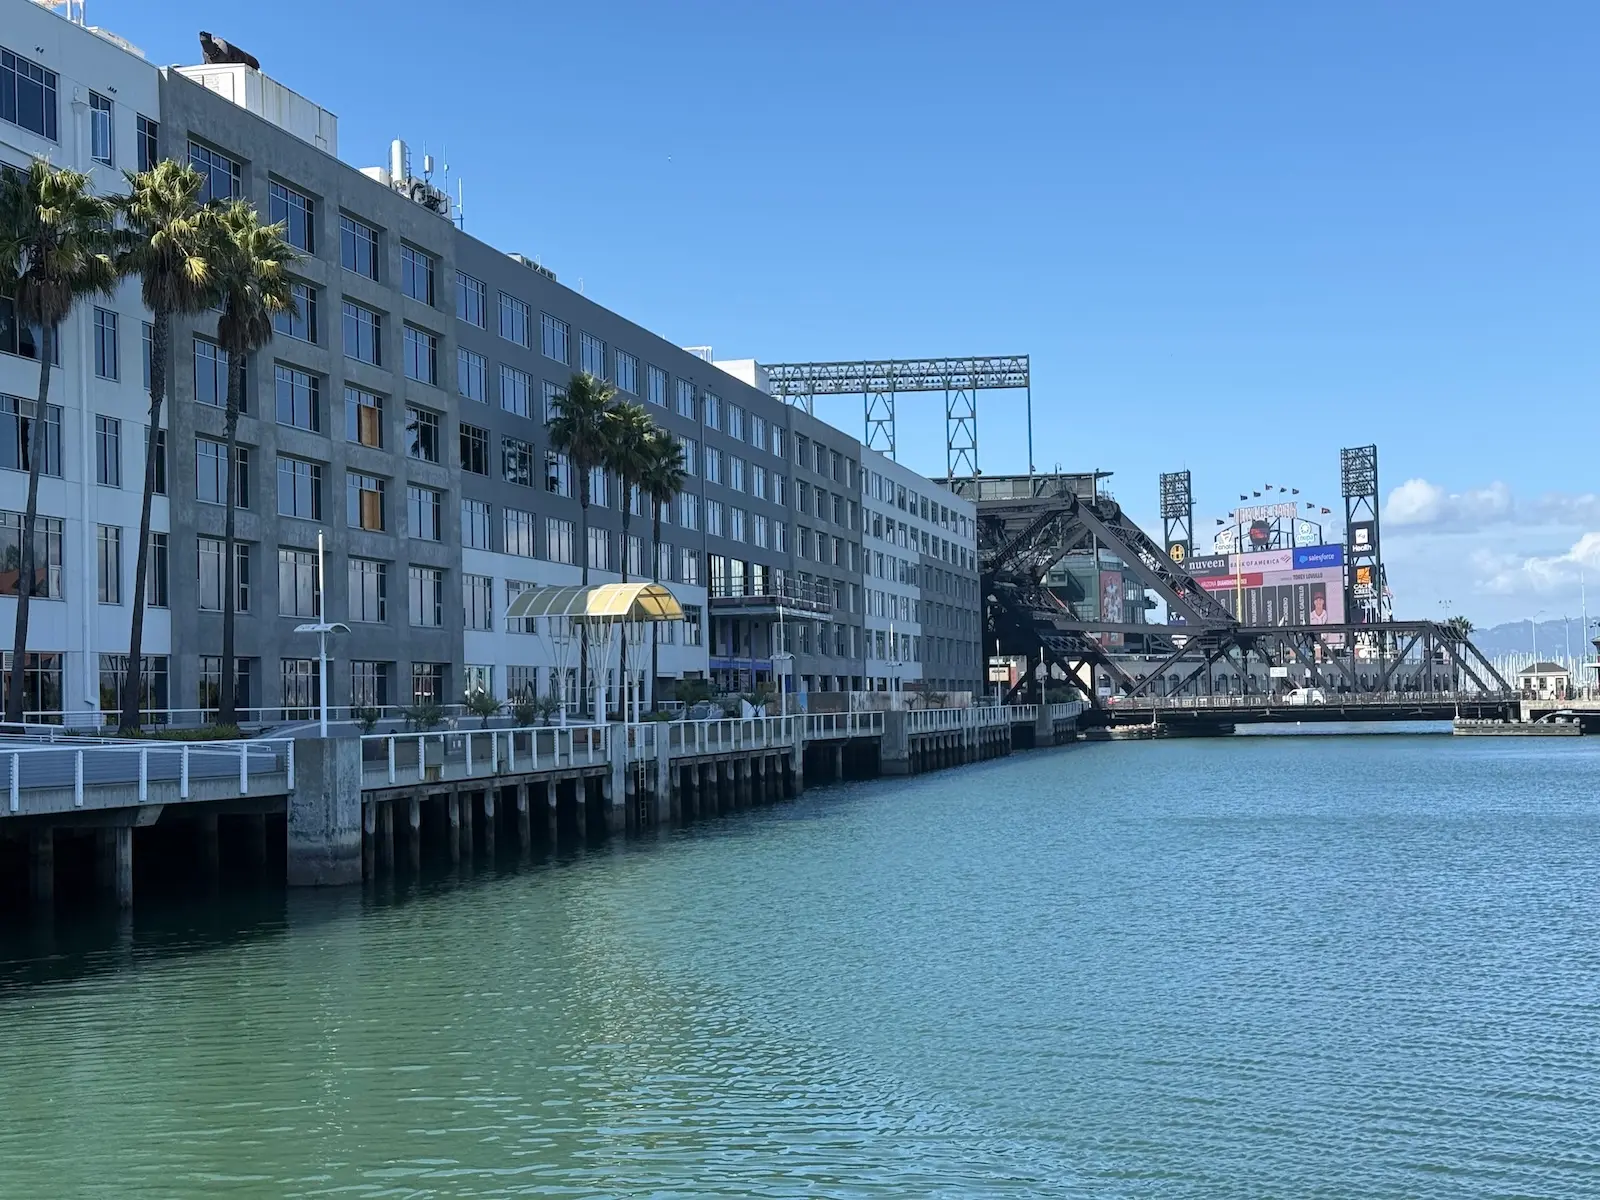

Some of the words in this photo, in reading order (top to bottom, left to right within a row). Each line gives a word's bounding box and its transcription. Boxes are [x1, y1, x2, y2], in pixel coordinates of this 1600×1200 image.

[1352, 544, 1372, 552] Health
[1309, 553, 1334, 562] salesforce
[1189, 560, 1225, 569] nuveen
[1254, 558, 1280, 566] AMERICA
